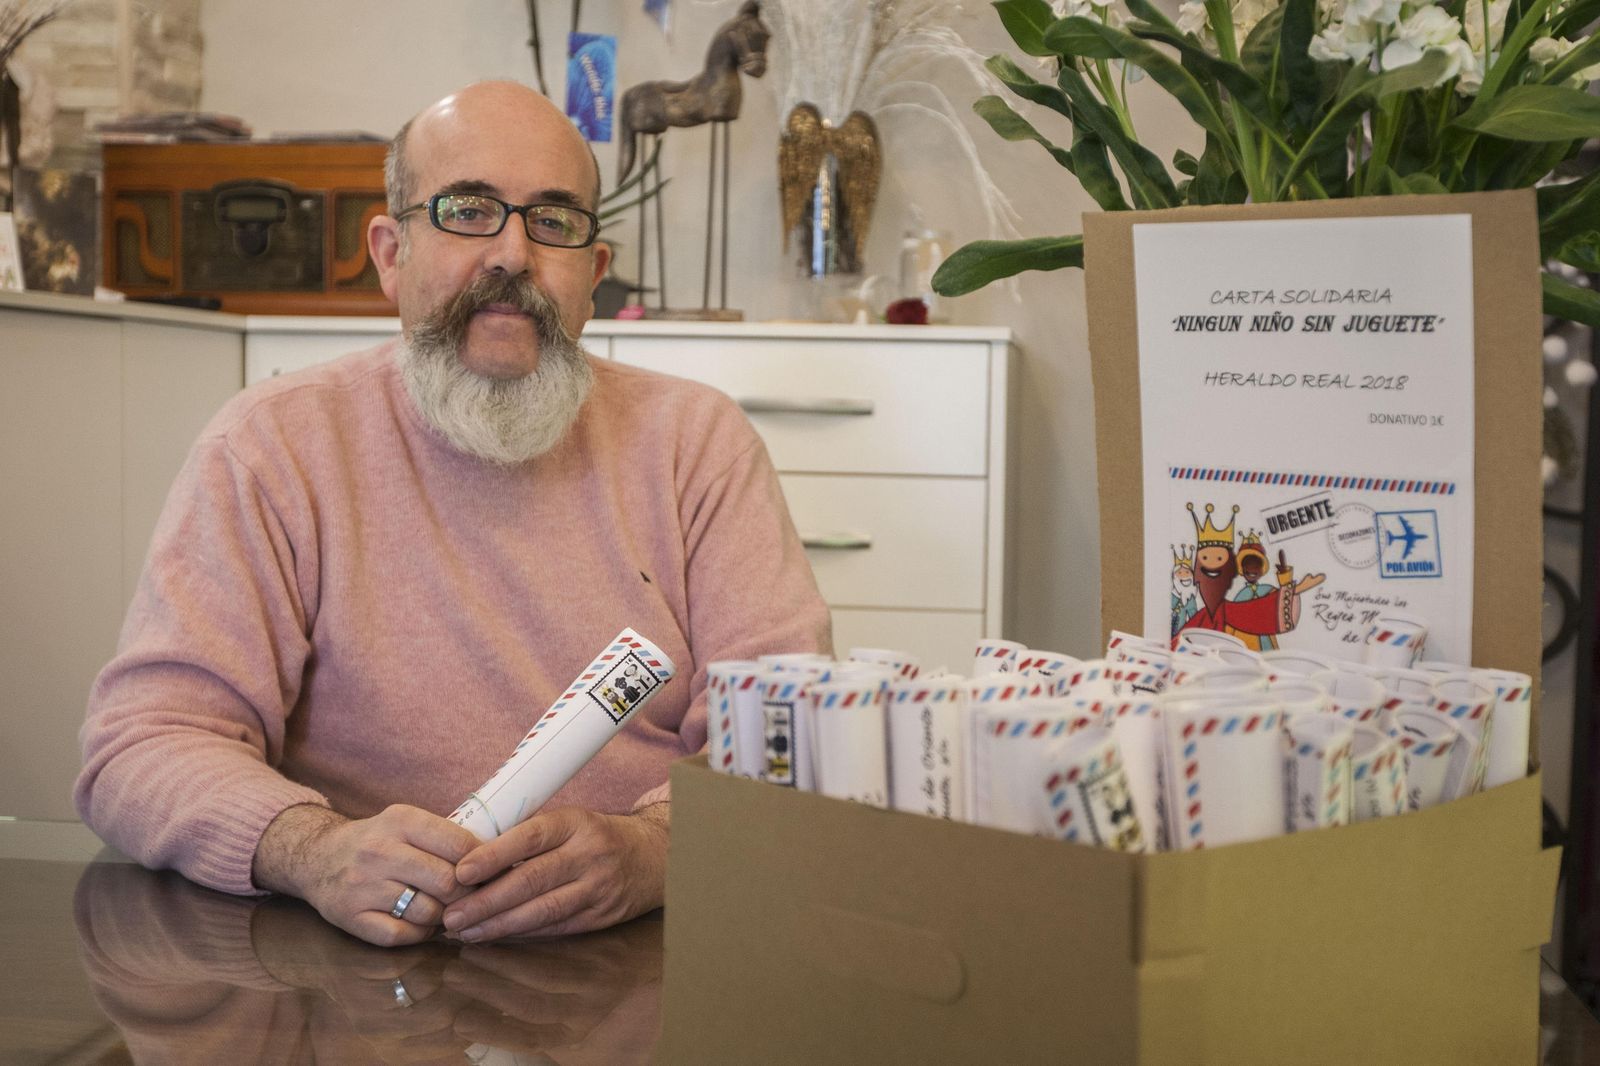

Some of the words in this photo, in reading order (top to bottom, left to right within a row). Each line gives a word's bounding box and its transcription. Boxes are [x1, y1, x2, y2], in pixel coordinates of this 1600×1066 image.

[1210, 288, 1276, 304] CARTA
[1279, 287, 1393, 304] SOLIDARIA
[1249, 310, 1295, 332] NIÑO
[1301, 314, 1336, 333] SIN
[1204, 371, 1298, 388] HERALDO
[1302, 373, 1357, 389] REAL
[1360, 374, 1410, 390] 2018
[1369, 412, 1428, 426] DONATIVO
[1265, 498, 1336, 536] URGENTE
[1386, 560, 1405, 573] POR
[1312, 603, 1355, 631] Reyes
[1342, 630, 1360, 643] de
